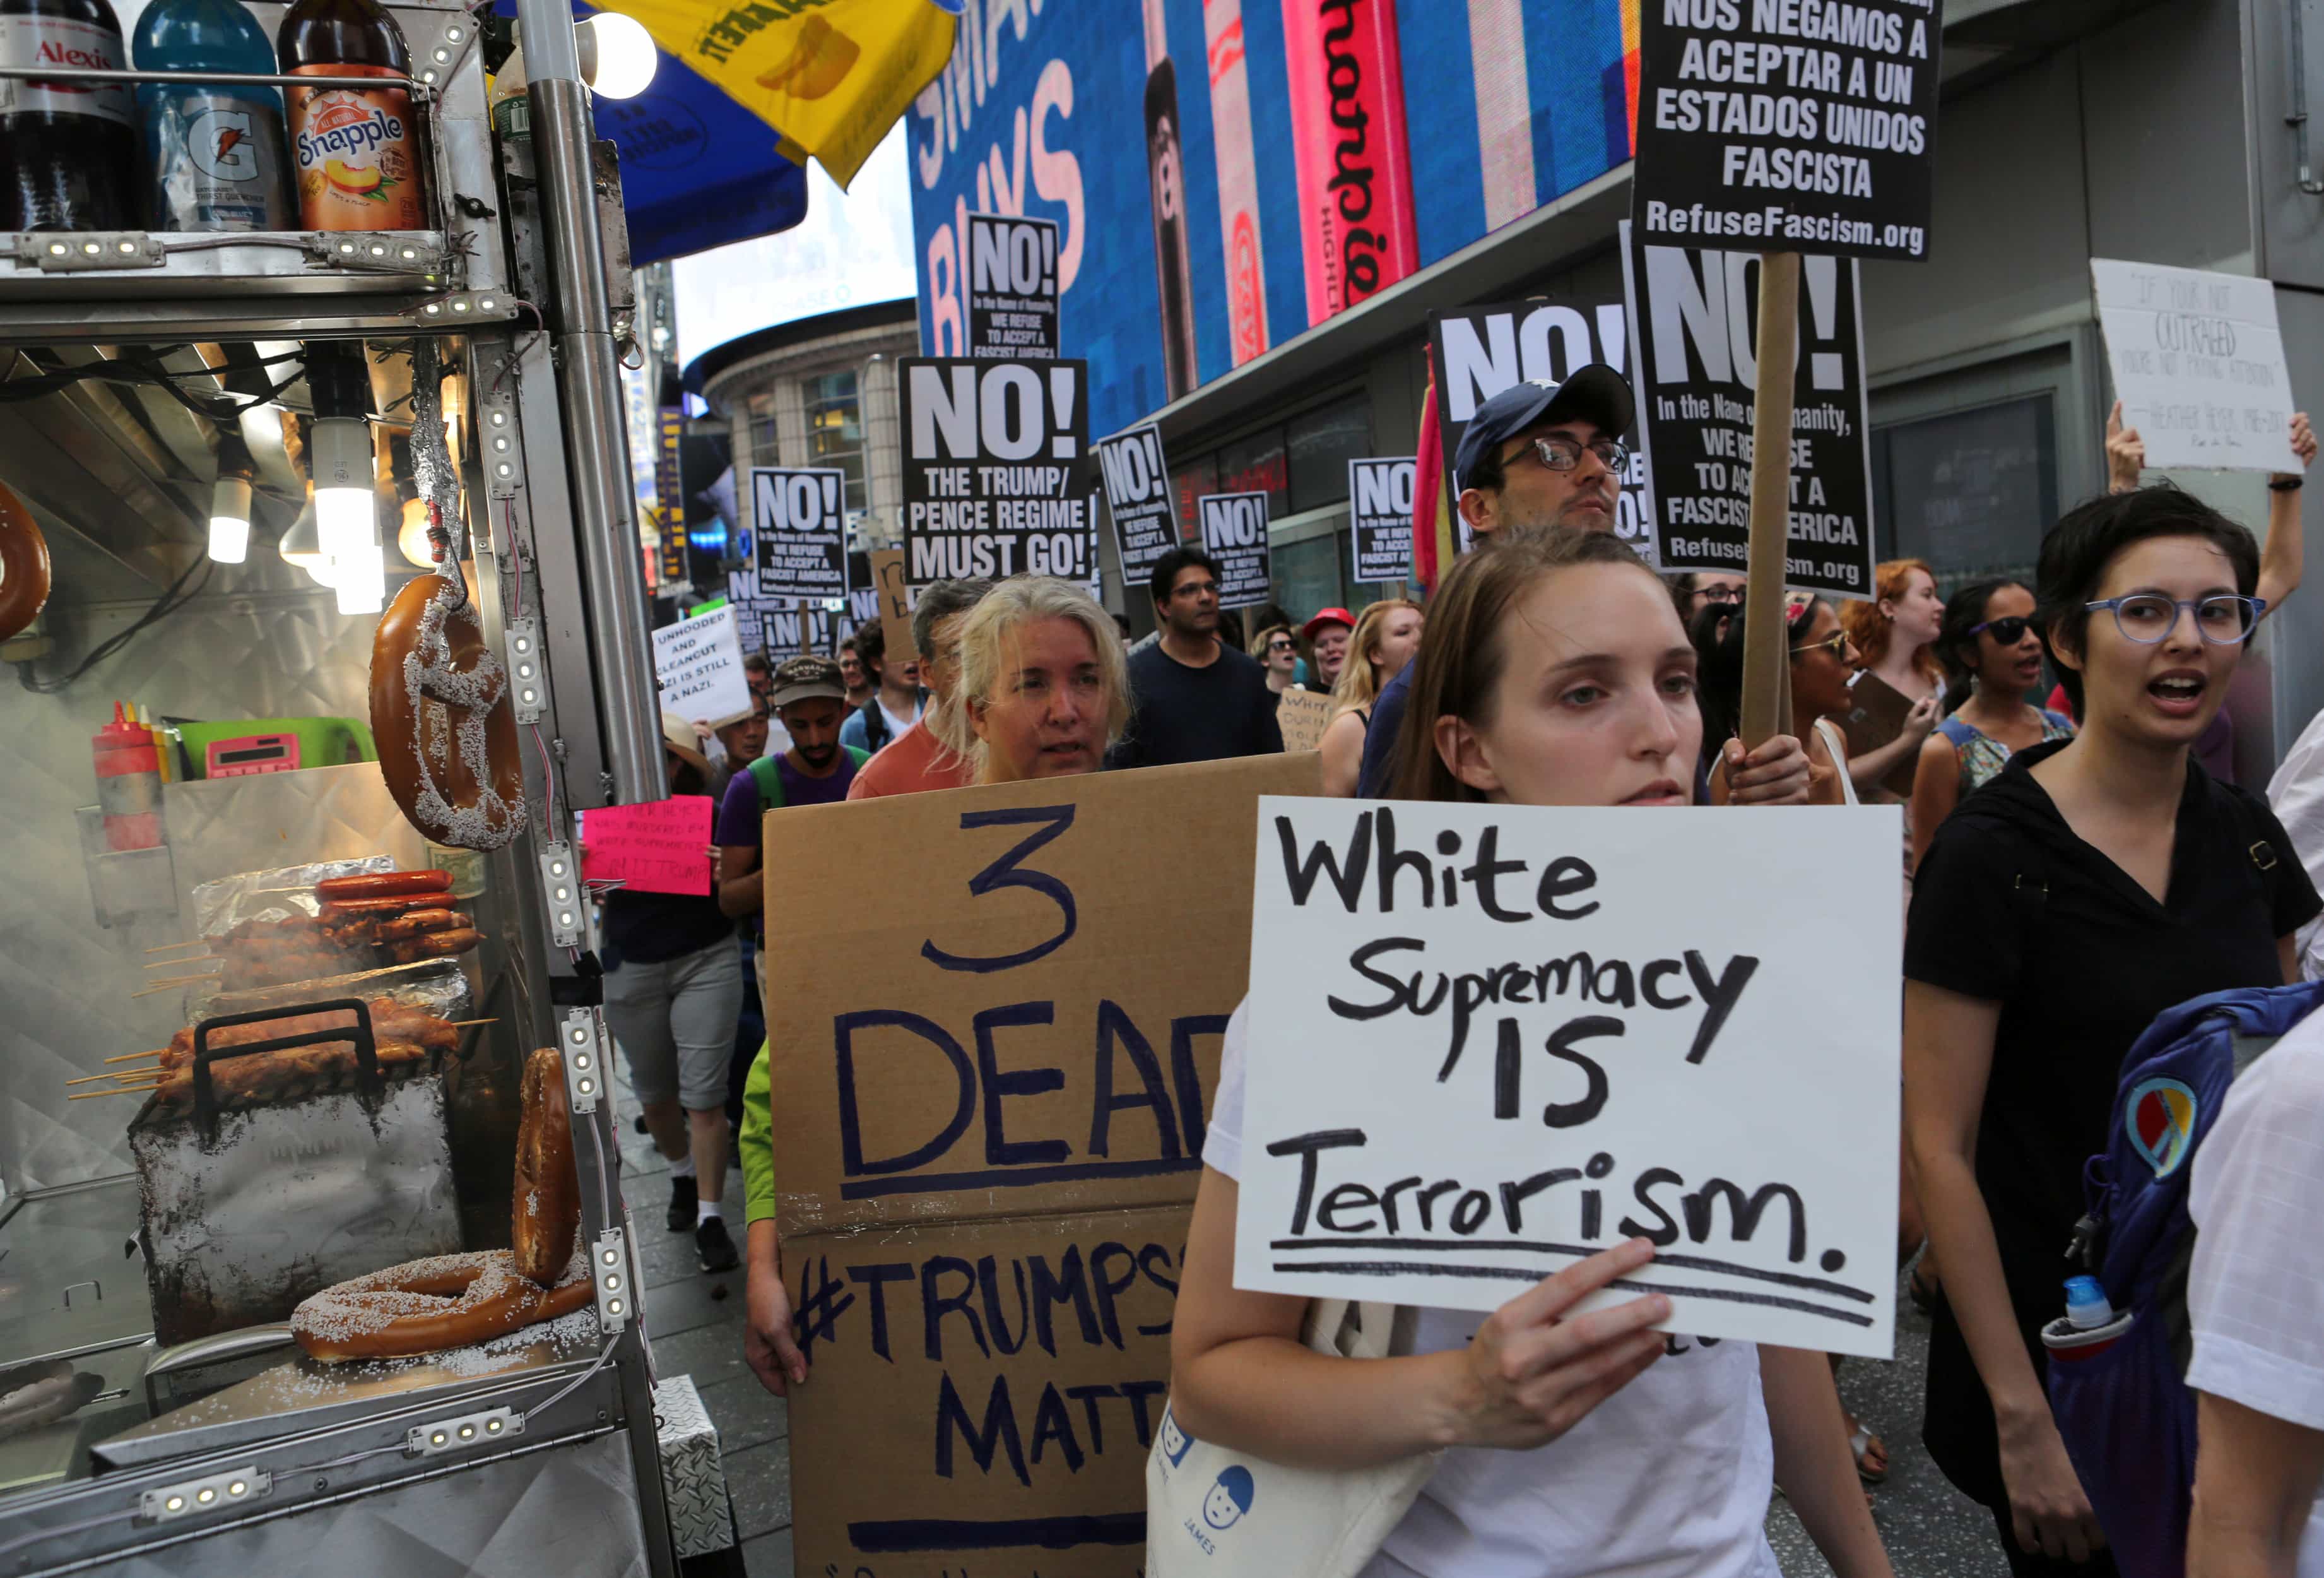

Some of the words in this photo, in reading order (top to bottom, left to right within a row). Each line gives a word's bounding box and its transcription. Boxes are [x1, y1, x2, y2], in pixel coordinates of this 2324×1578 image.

[1752, 0, 1902, 54] NEGAMOS
[1908, 19, 1928, 59] A
[36, 40, 111, 70] Alexis
[1678, 38, 1841, 93] ACEPTAR
[1847, 57, 1867, 98] A
[1874, 61, 1913, 105] UN
[298, 110, 403, 167] Snapple
[1655, 87, 1819, 140] ESTADOS
[1826, 102, 1925, 155] UNIDOS
[1723, 145, 1872, 198] FASCISTA
[1646, 200, 1924, 256] RefuseFascism.org
[973, 222, 1054, 295] NO!
[986, 329, 1002, 344] TO
[1003, 331, 1037, 344] ACCEPT
[1037, 331, 1046, 345] A
[991, 313, 1008, 328] WE
[1009, 314, 1042, 329] REFUSE
[2155, 312, 2238, 358] OUTRAGED
[910, 364, 1075, 460] NO!
[1658, 396, 1676, 421] In
[1680, 394, 1709, 419] the
[1713, 393, 1744, 424] Name
[1745, 405, 1755, 426] o
[1102, 433, 1164, 505] NO!
[1702, 428, 1736, 458] WE
[1737, 431, 1814, 469] RESE
[757, 474, 839, 531] NO!
[924, 466, 970, 497] THE
[978, 466, 1070, 497] TRUMP/
[1695, 462, 1726, 491] TO
[1808, 477, 1826, 506] A
[911, 501, 993, 531] PENCE
[996, 499, 1084, 530] REGIME
[1206, 497, 1265, 549] NO!
[1786, 511, 1858, 546] ERICA
[770, 555, 783, 568] TO
[821, 557, 830, 569] A
[912, 534, 1017, 579] MUST
[1027, 533, 1085, 576] GO!
[1670, 537, 1860, 586] Refusesm.org
[658, 612, 725, 645] UNHOODED
[672, 639, 696, 655] AND
[656, 643, 717, 676] CLEANCUT
[680, 671, 692, 682] IS
[695, 658, 731, 677] STILL
[670, 692, 679, 703] A
[921, 803, 1076, 973] 3
[1275, 806, 1600, 923] White
[1327, 937, 1759, 1083] Supremacy
[1494, 1015, 1625, 1129] IS
[1266, 1128, 1846, 1272] Terrorism.
[793, 1242, 1184, 1365] #TRUMPS
[1184, 1517, 1216, 1557] JAMES
